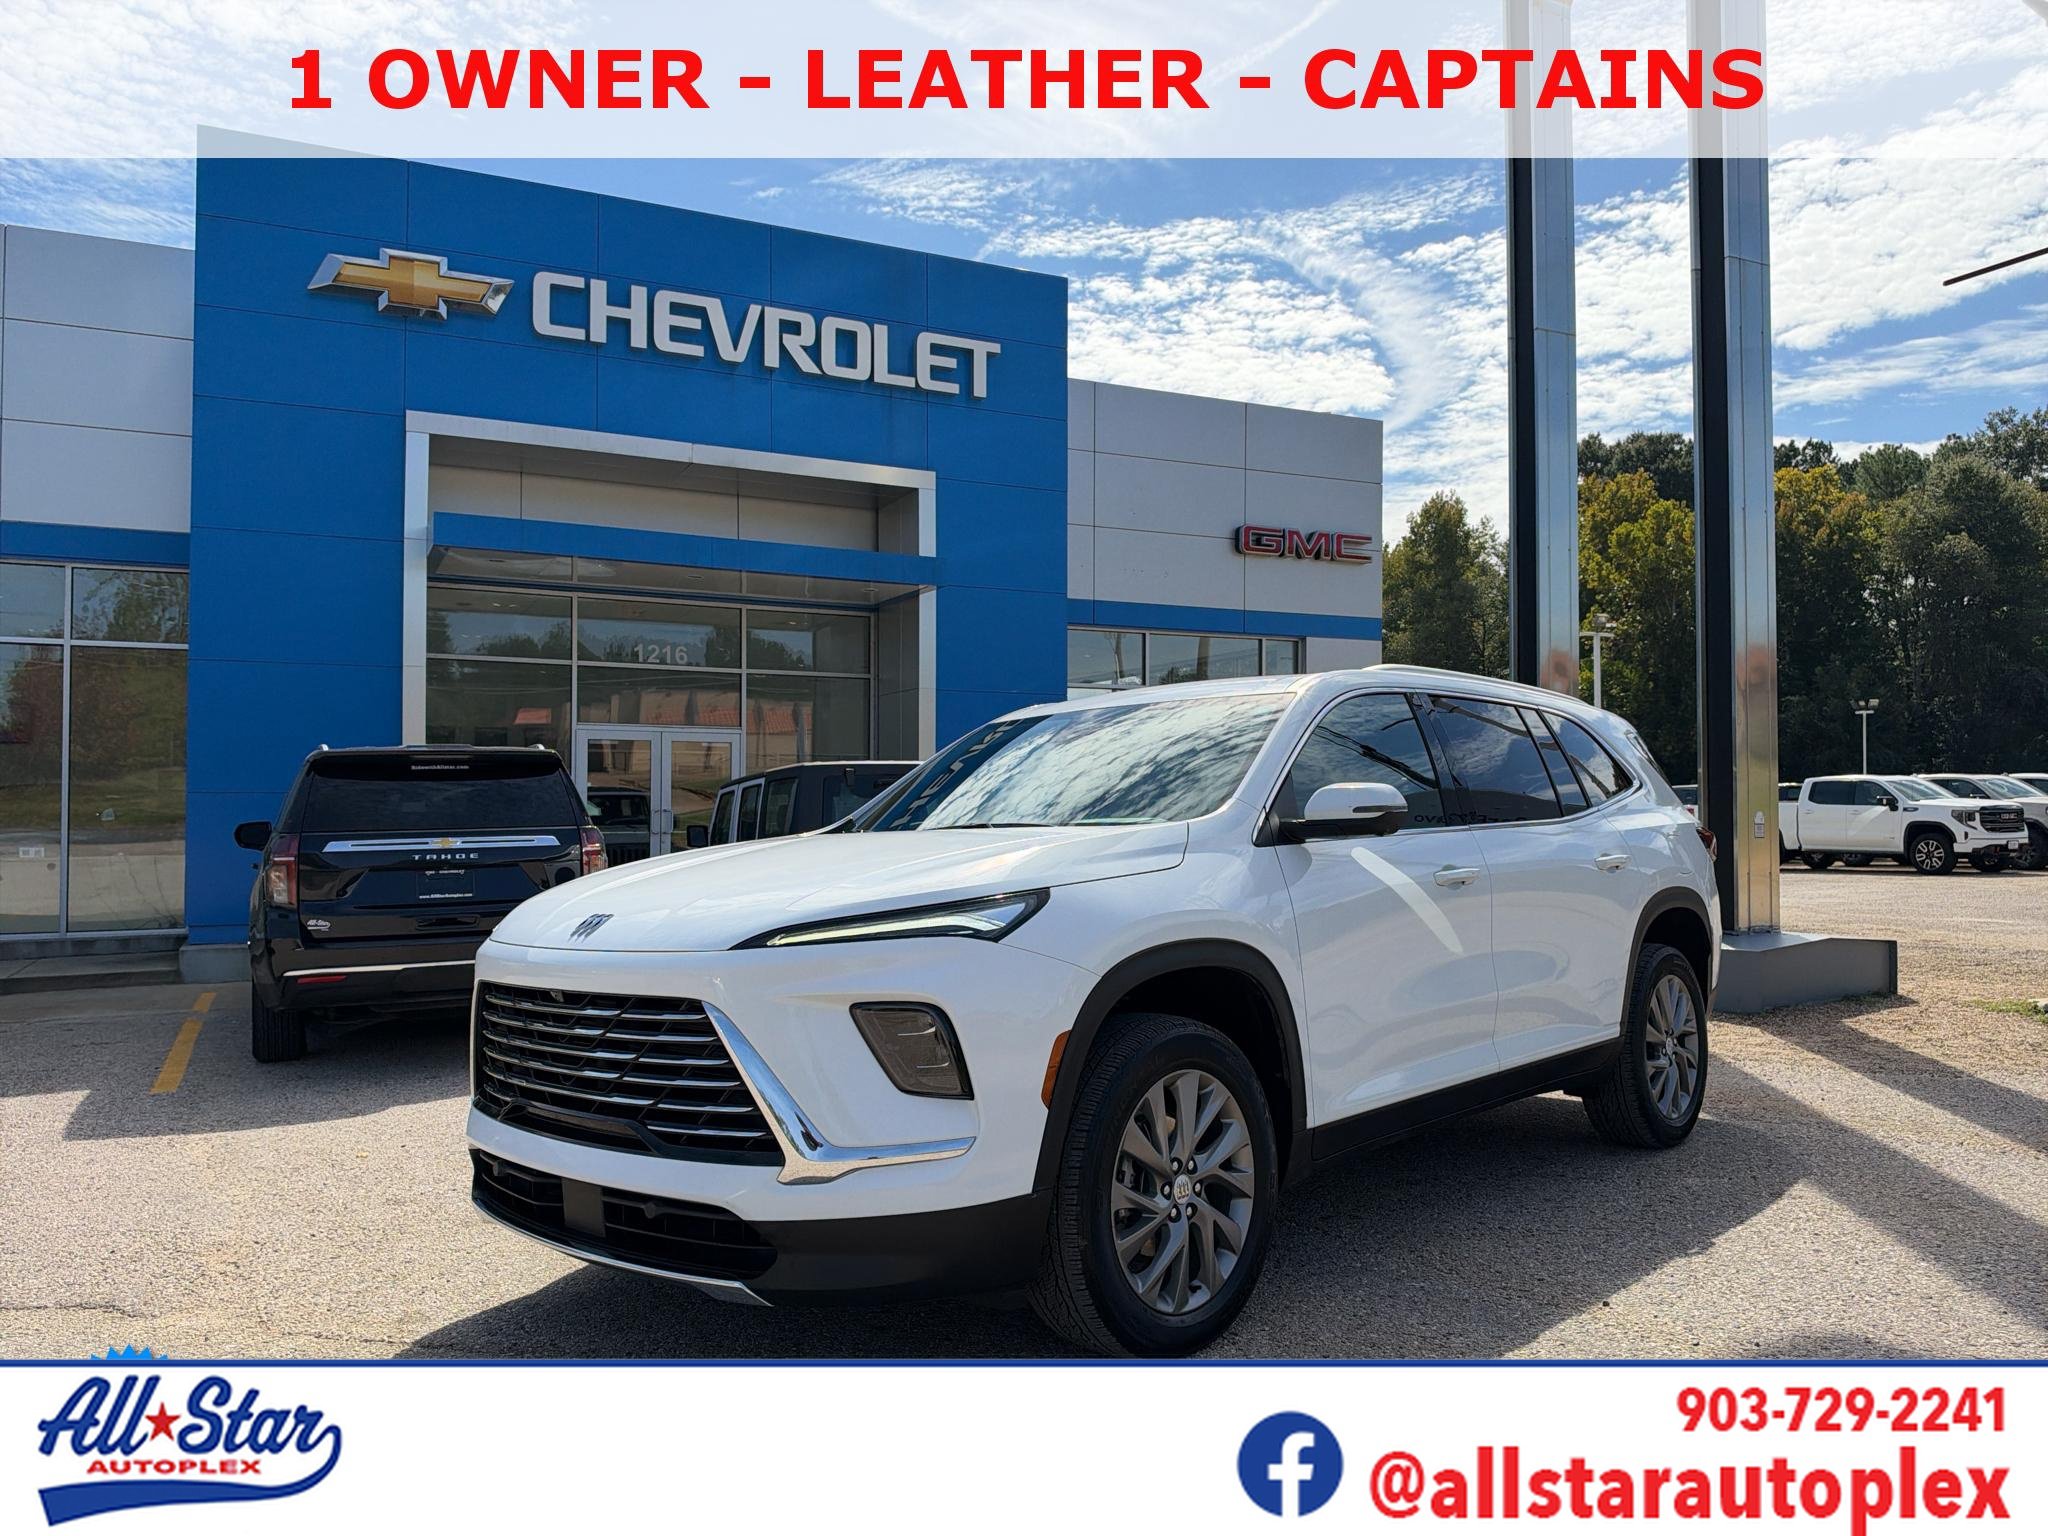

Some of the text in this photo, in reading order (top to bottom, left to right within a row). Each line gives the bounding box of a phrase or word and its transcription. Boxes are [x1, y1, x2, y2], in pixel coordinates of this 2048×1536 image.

[532, 271, 1001, 399] CHEVROLET
[1237, 524, 1373, 562] GMC
[633, 643, 688, 665] 1216
